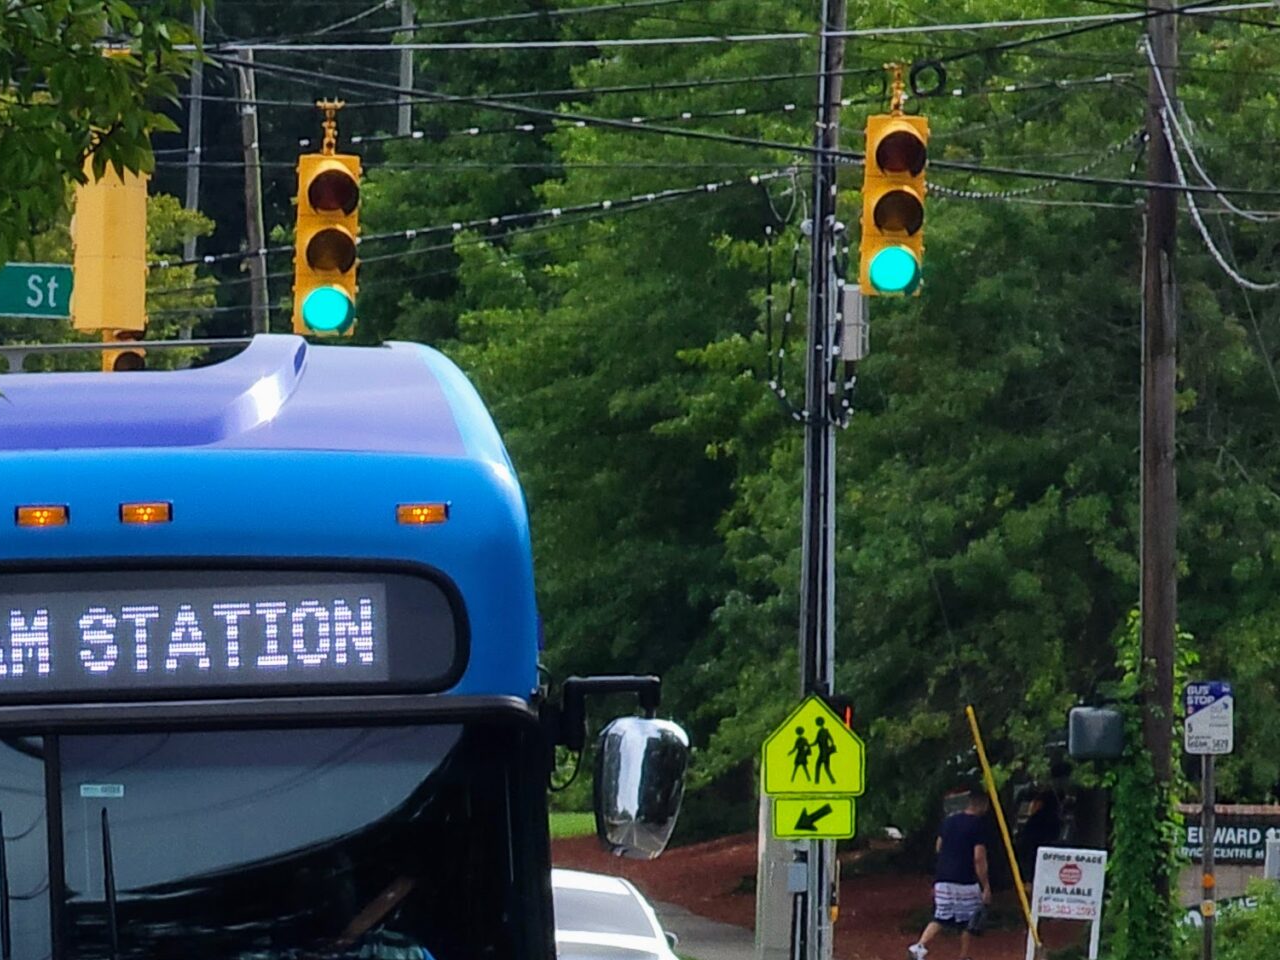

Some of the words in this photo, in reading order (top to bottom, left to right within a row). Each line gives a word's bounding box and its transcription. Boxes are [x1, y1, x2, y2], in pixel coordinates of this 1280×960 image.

[26, 274, 59, 308] St
[78, 598, 373, 673] STATION
[1187, 685, 1210, 696] BUS
[1187, 695, 1216, 705] STOP
[1042, 852, 1072, 862] OFFICE
[1074, 854, 1103, 864] SPACE
[1045, 886, 1092, 897] AVAILABLE
